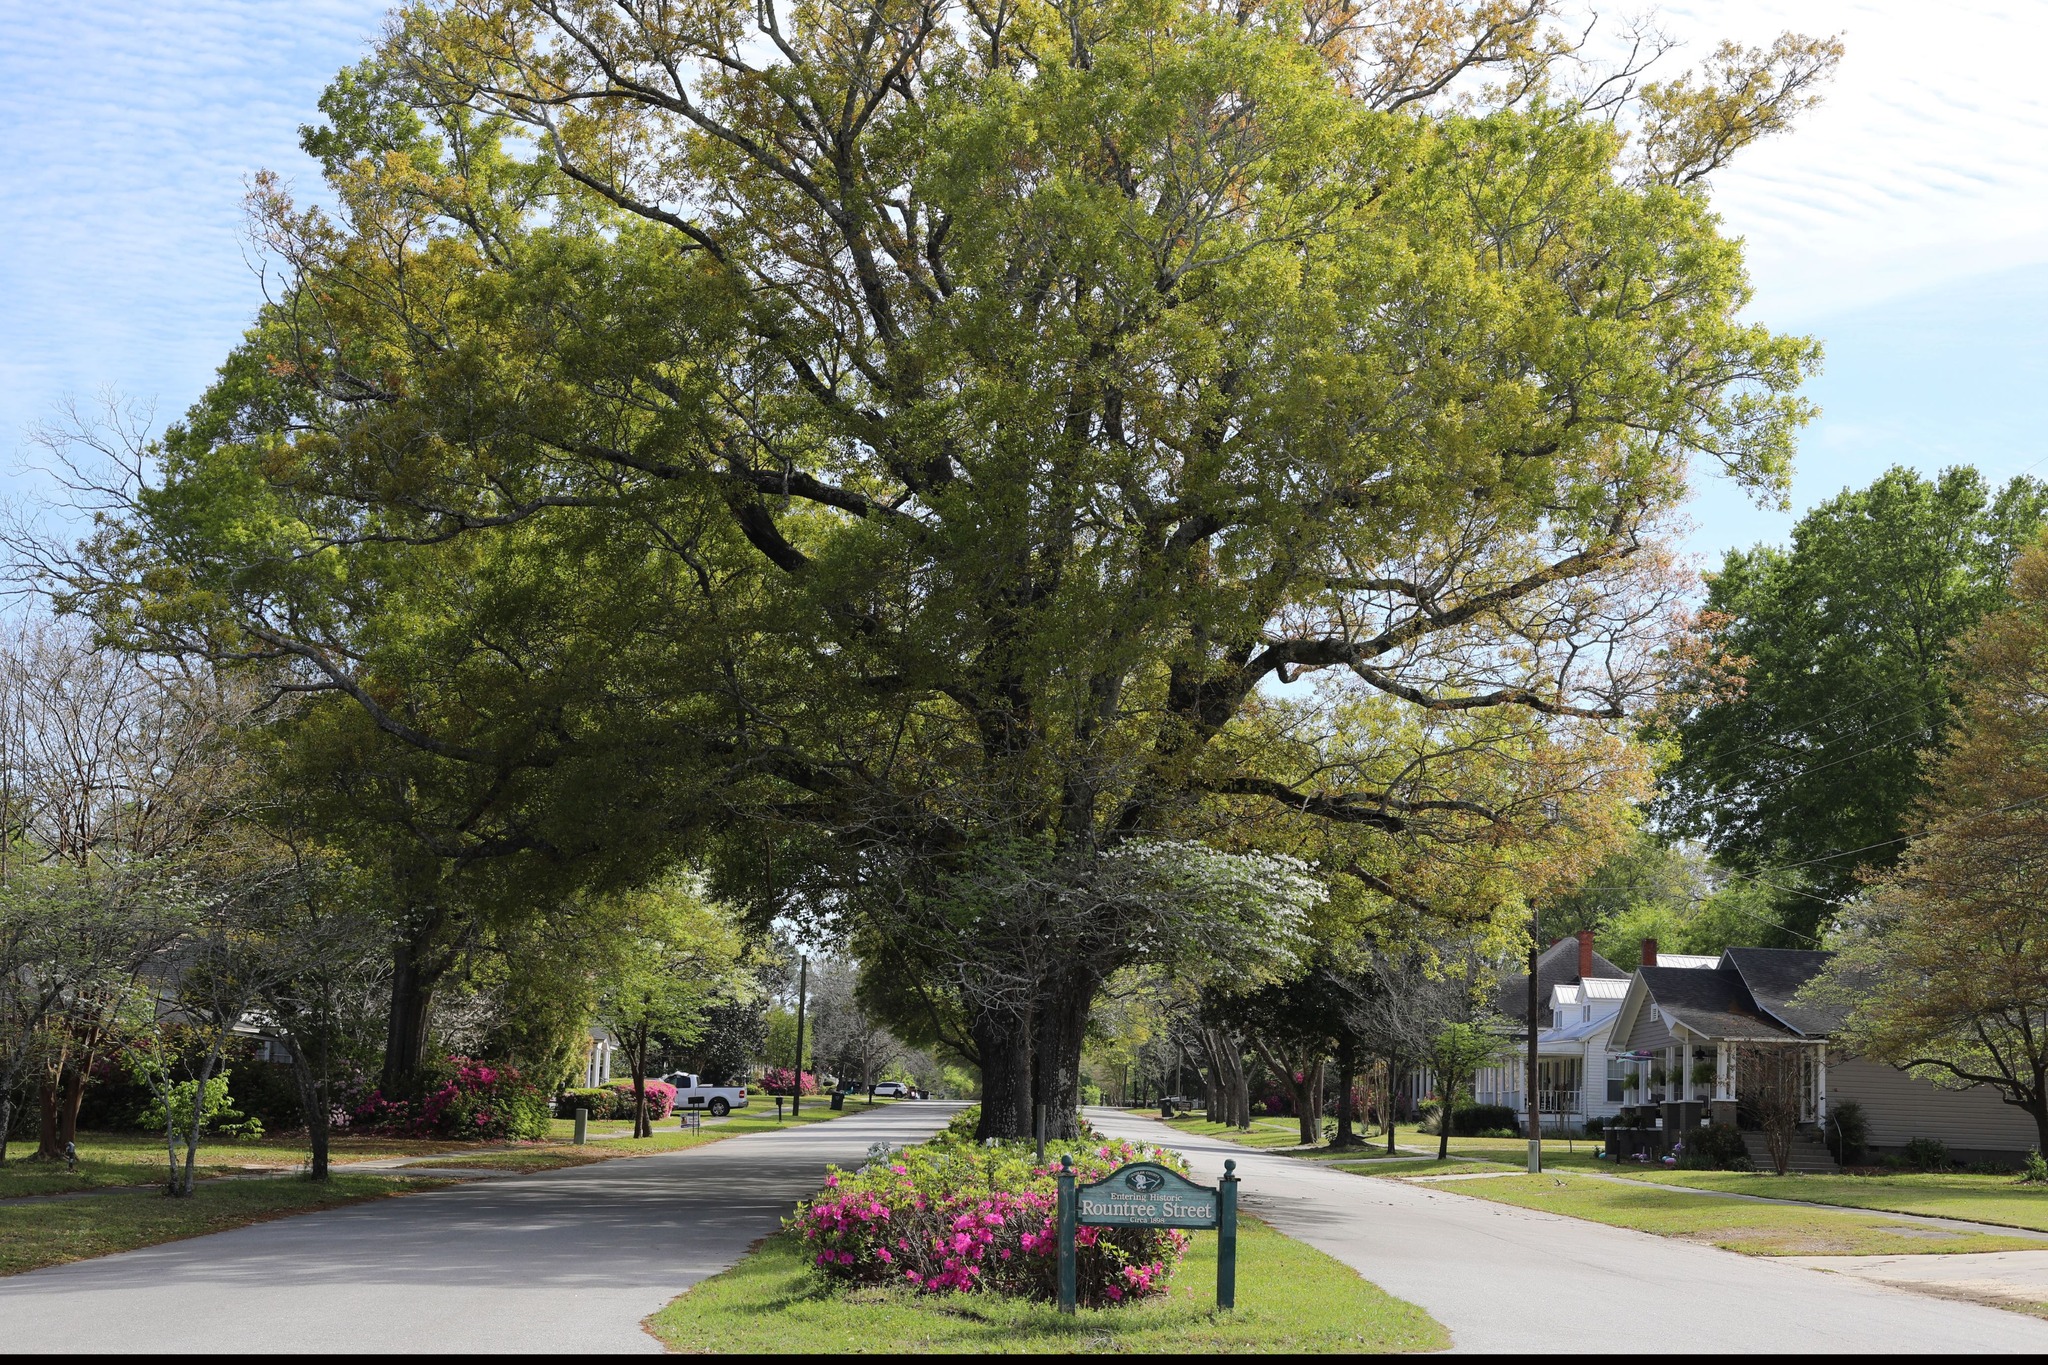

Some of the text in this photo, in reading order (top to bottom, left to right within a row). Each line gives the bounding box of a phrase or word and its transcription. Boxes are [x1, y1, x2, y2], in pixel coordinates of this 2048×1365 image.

[1110, 1193, 1183, 1202] Entering Historic
[1082, 1200, 1212, 1218] Rountree Street
[1129, 1216, 1147, 1224] Circa
